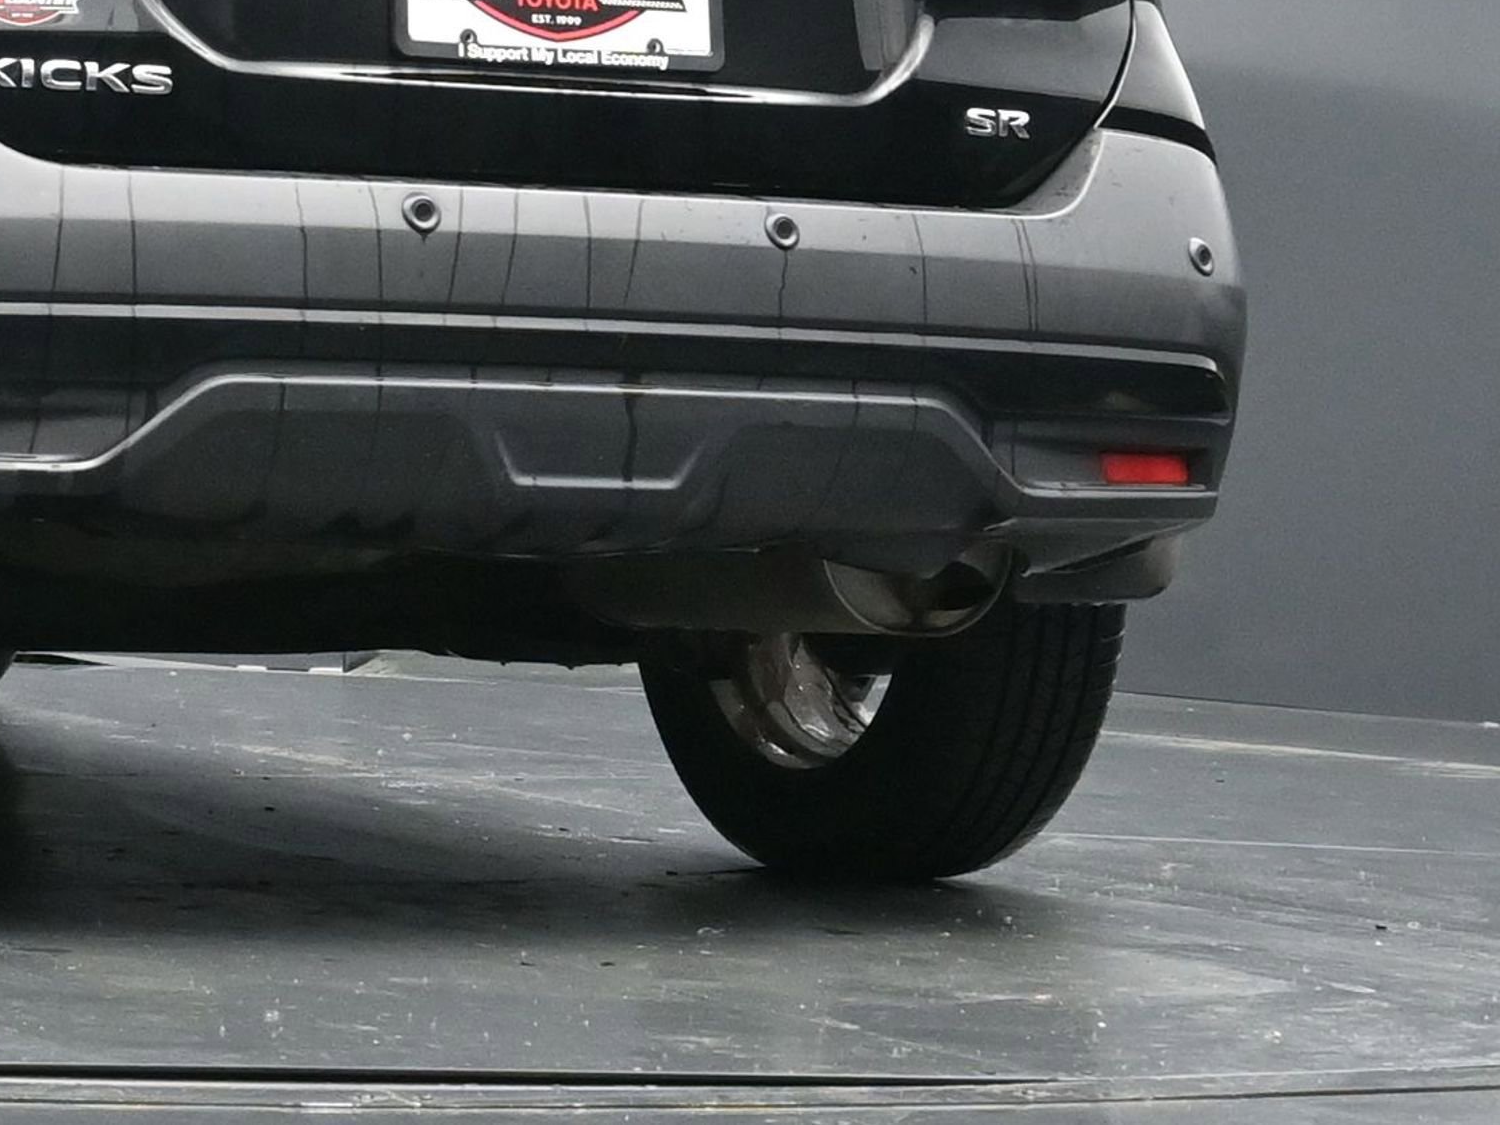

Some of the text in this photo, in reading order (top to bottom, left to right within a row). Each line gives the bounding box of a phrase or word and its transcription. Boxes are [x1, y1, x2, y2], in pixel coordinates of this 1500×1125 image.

[531, 13, 555, 25] EST.
[458, 42, 669, 71] I Support My Local Economy
[965, 107, 1031, 140] SR
